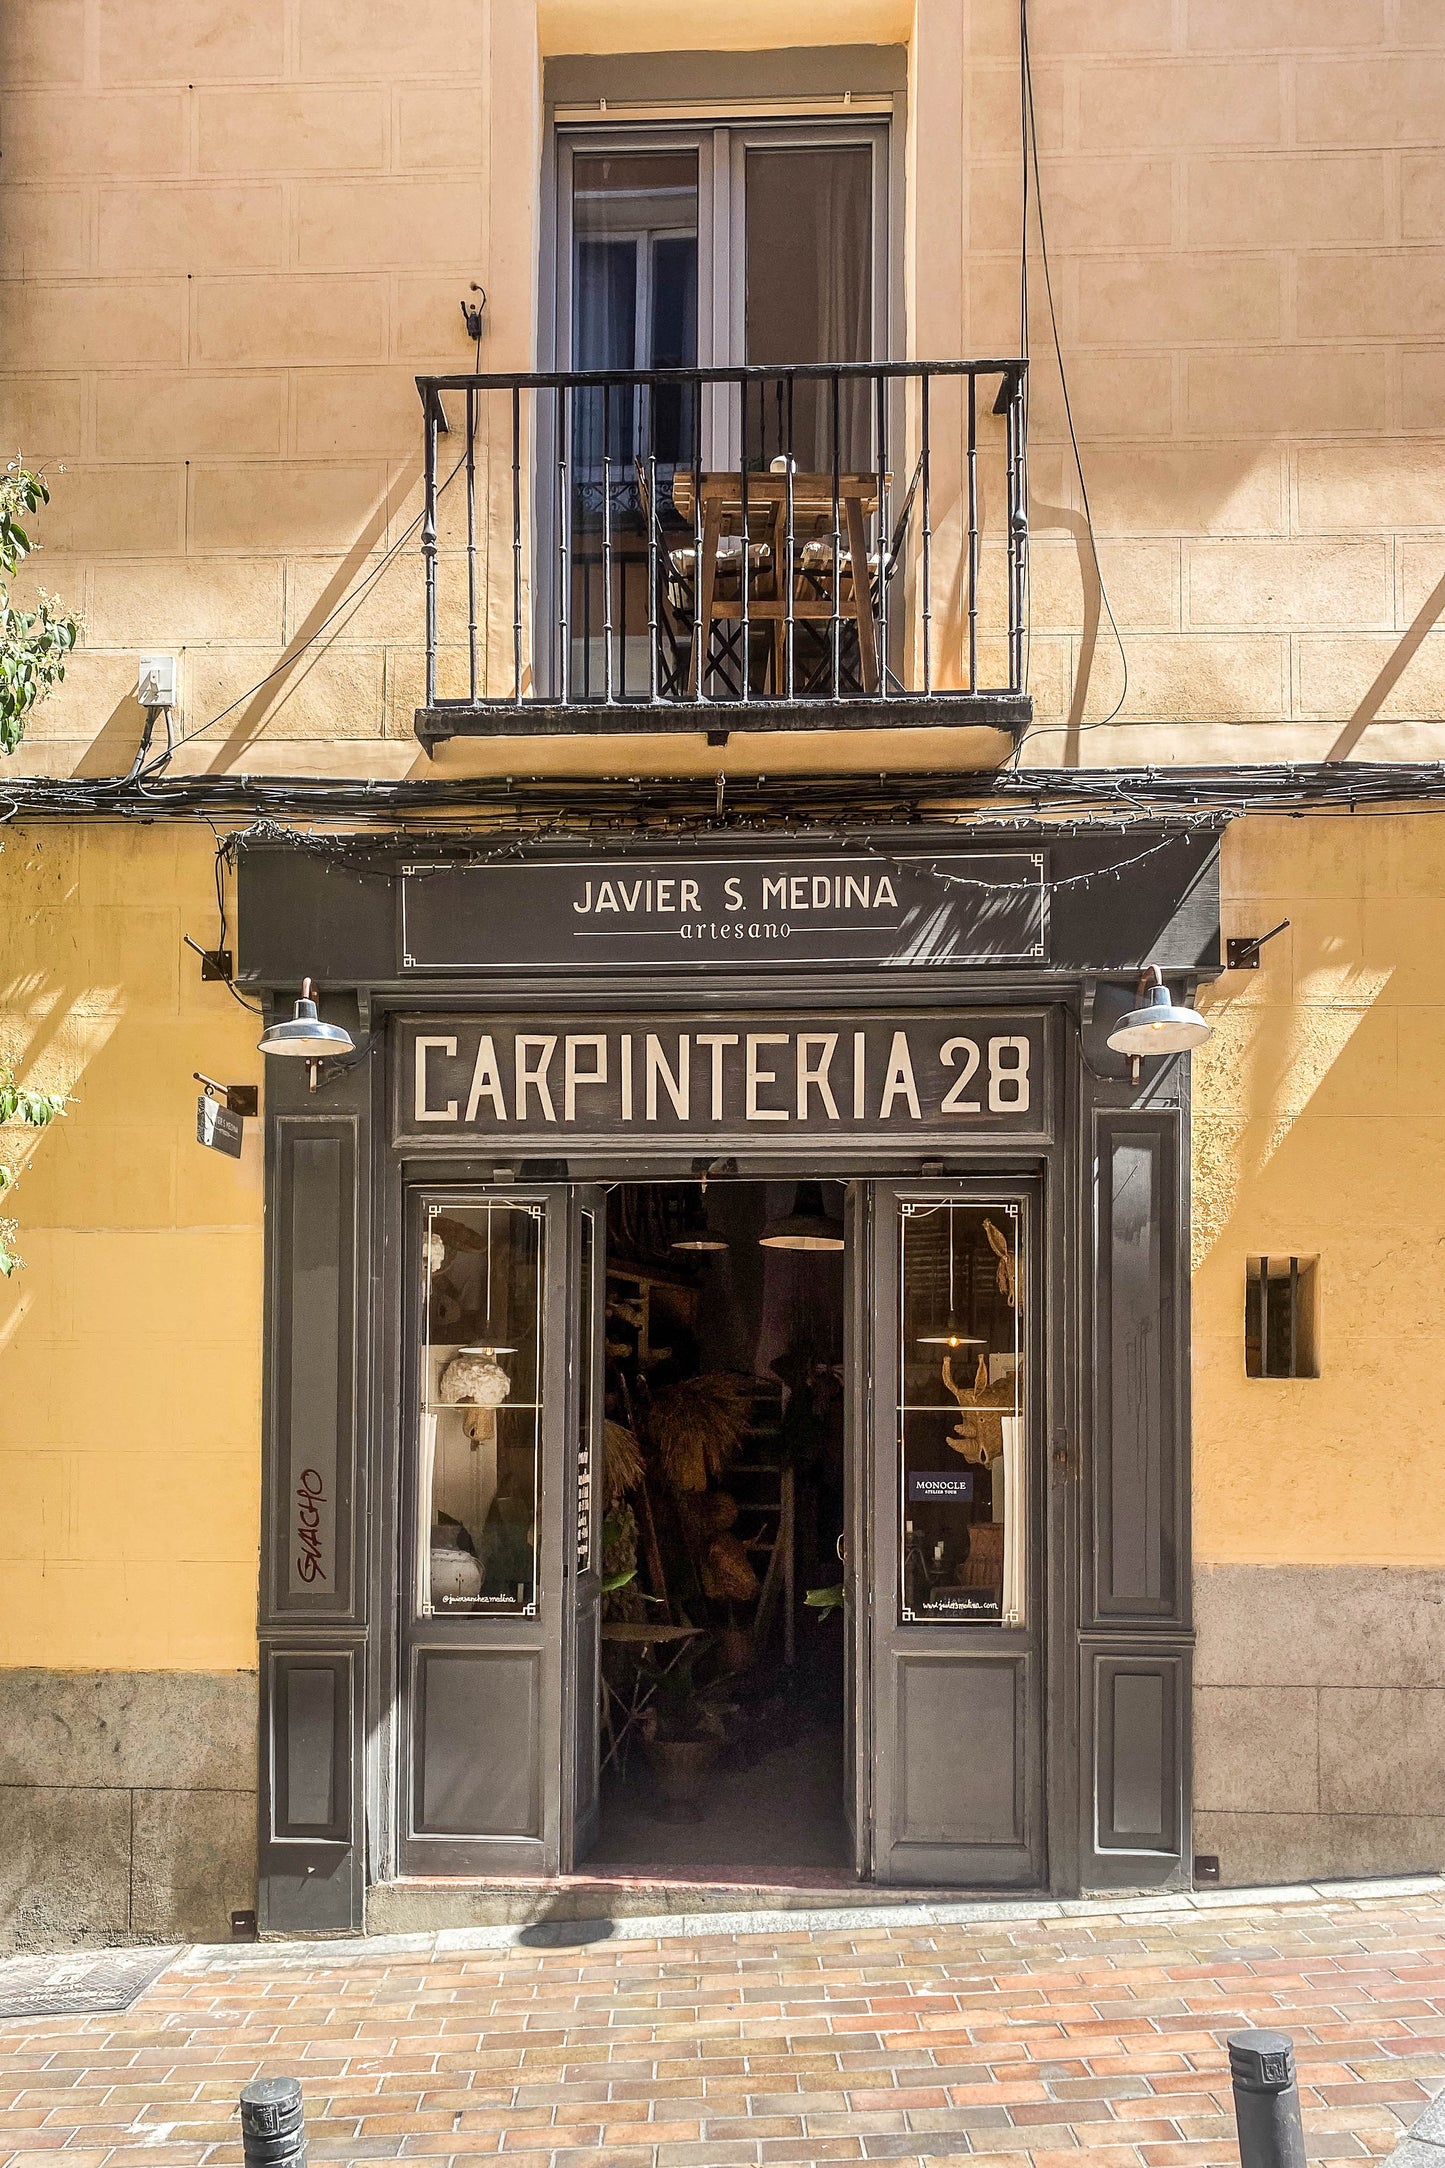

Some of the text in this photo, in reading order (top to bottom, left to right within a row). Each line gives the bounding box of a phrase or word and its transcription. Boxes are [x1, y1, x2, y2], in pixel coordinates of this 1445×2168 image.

[573, 875, 898, 914] JAVIER S. MEDINA
[680, 922, 791, 939] artesano
[414, 1031, 1030, 1122] CARPINTERIA 28
[916, 1481, 966, 1490] MONOCLE
